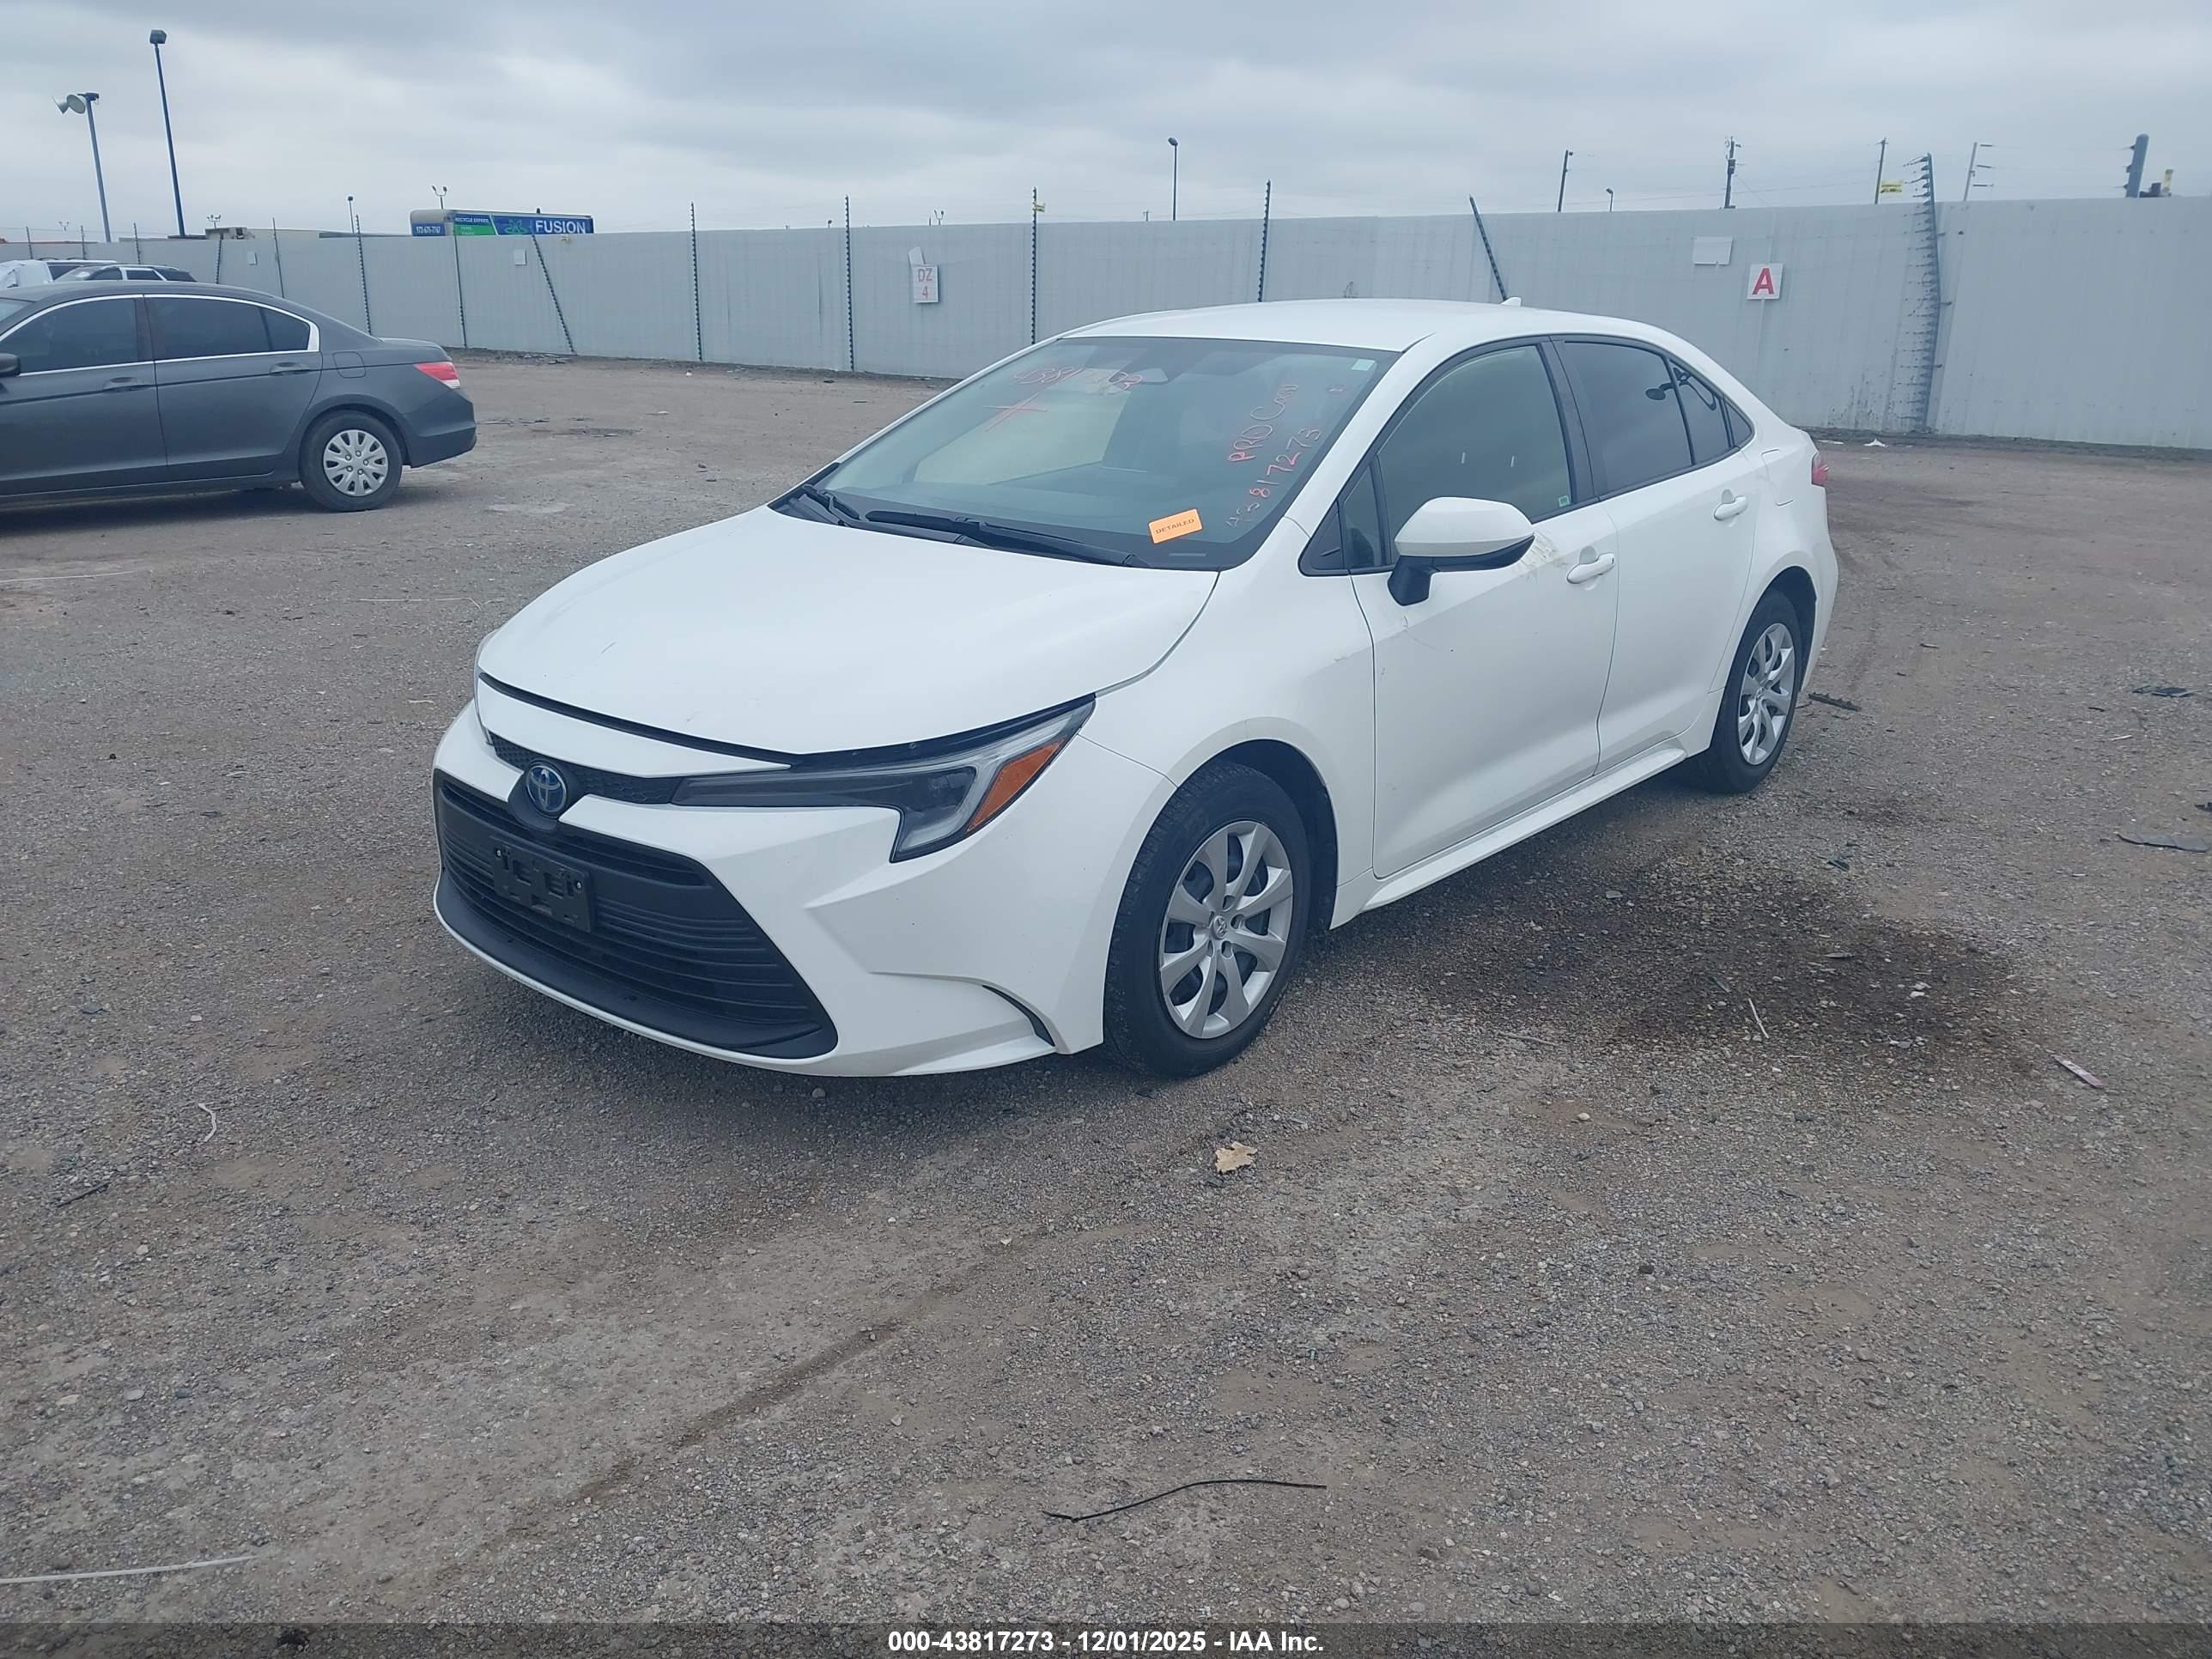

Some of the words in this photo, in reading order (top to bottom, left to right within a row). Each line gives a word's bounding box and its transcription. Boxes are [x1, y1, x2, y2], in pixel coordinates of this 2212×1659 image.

[535, 220, 586, 234] FUSION
[1752, 267, 1774, 295] A
[921, 286, 929, 299] 4
[1155, 518, 1195, 534] DETAILED
